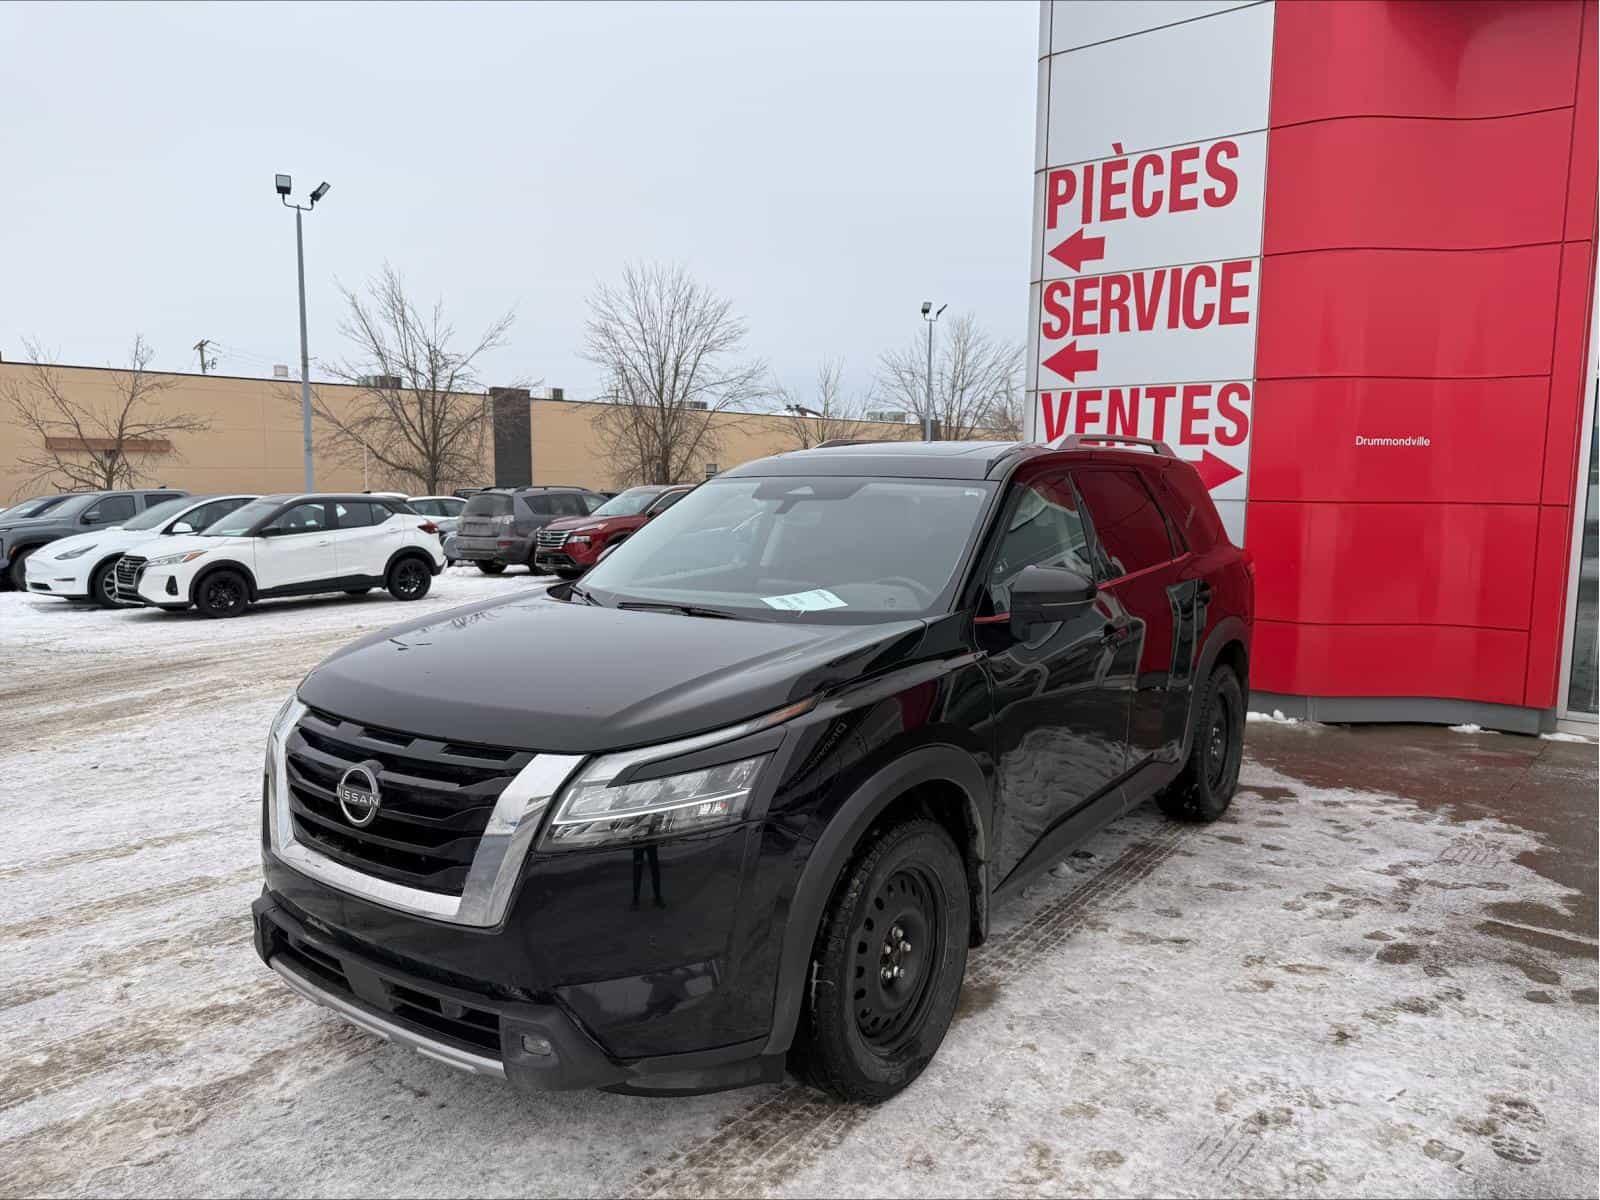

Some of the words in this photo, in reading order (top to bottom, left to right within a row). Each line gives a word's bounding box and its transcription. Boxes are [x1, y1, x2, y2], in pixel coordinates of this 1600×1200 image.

[1047, 140, 1239, 229] PIÈCES
[1042, 260, 1252, 339] SERVICE
[1041, 382, 1250, 446] VENTES
[1355, 435, 1431, 447] Drummondville
[336, 784, 380, 807] NISSAN
